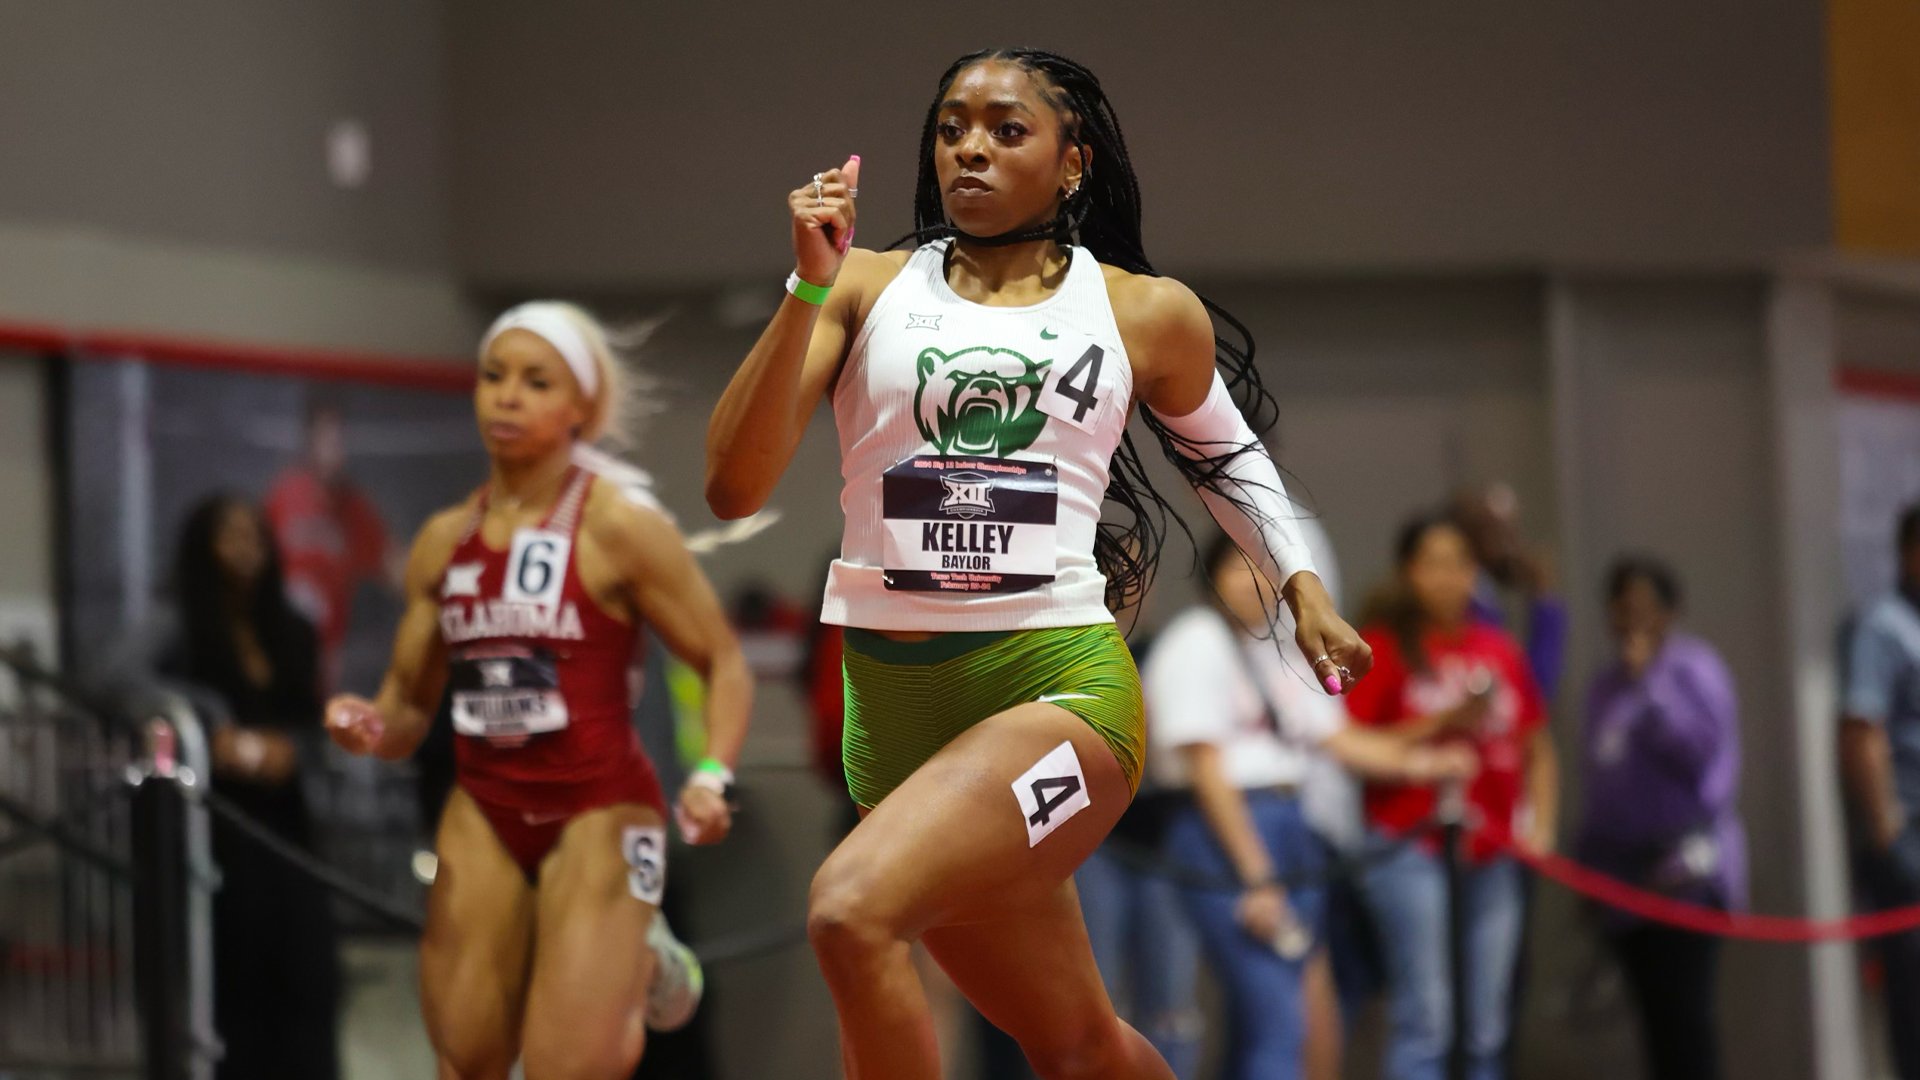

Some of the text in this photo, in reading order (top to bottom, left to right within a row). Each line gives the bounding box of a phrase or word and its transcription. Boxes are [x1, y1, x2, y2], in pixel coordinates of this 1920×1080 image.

[1055, 343, 1105, 424] 4
[933, 460, 944, 470] Big
[955, 461, 976, 470] Indoor
[977, 462, 1027, 475] Championships
[922, 522, 1014, 555] KELLEY
[518, 540, 555, 595] 6
[930, 572, 1002, 583] Texas Tech University
[941, 555, 991, 571] BAYLOR
[1028, 774, 1082, 828] 4
[631, 835, 658, 894] 6
